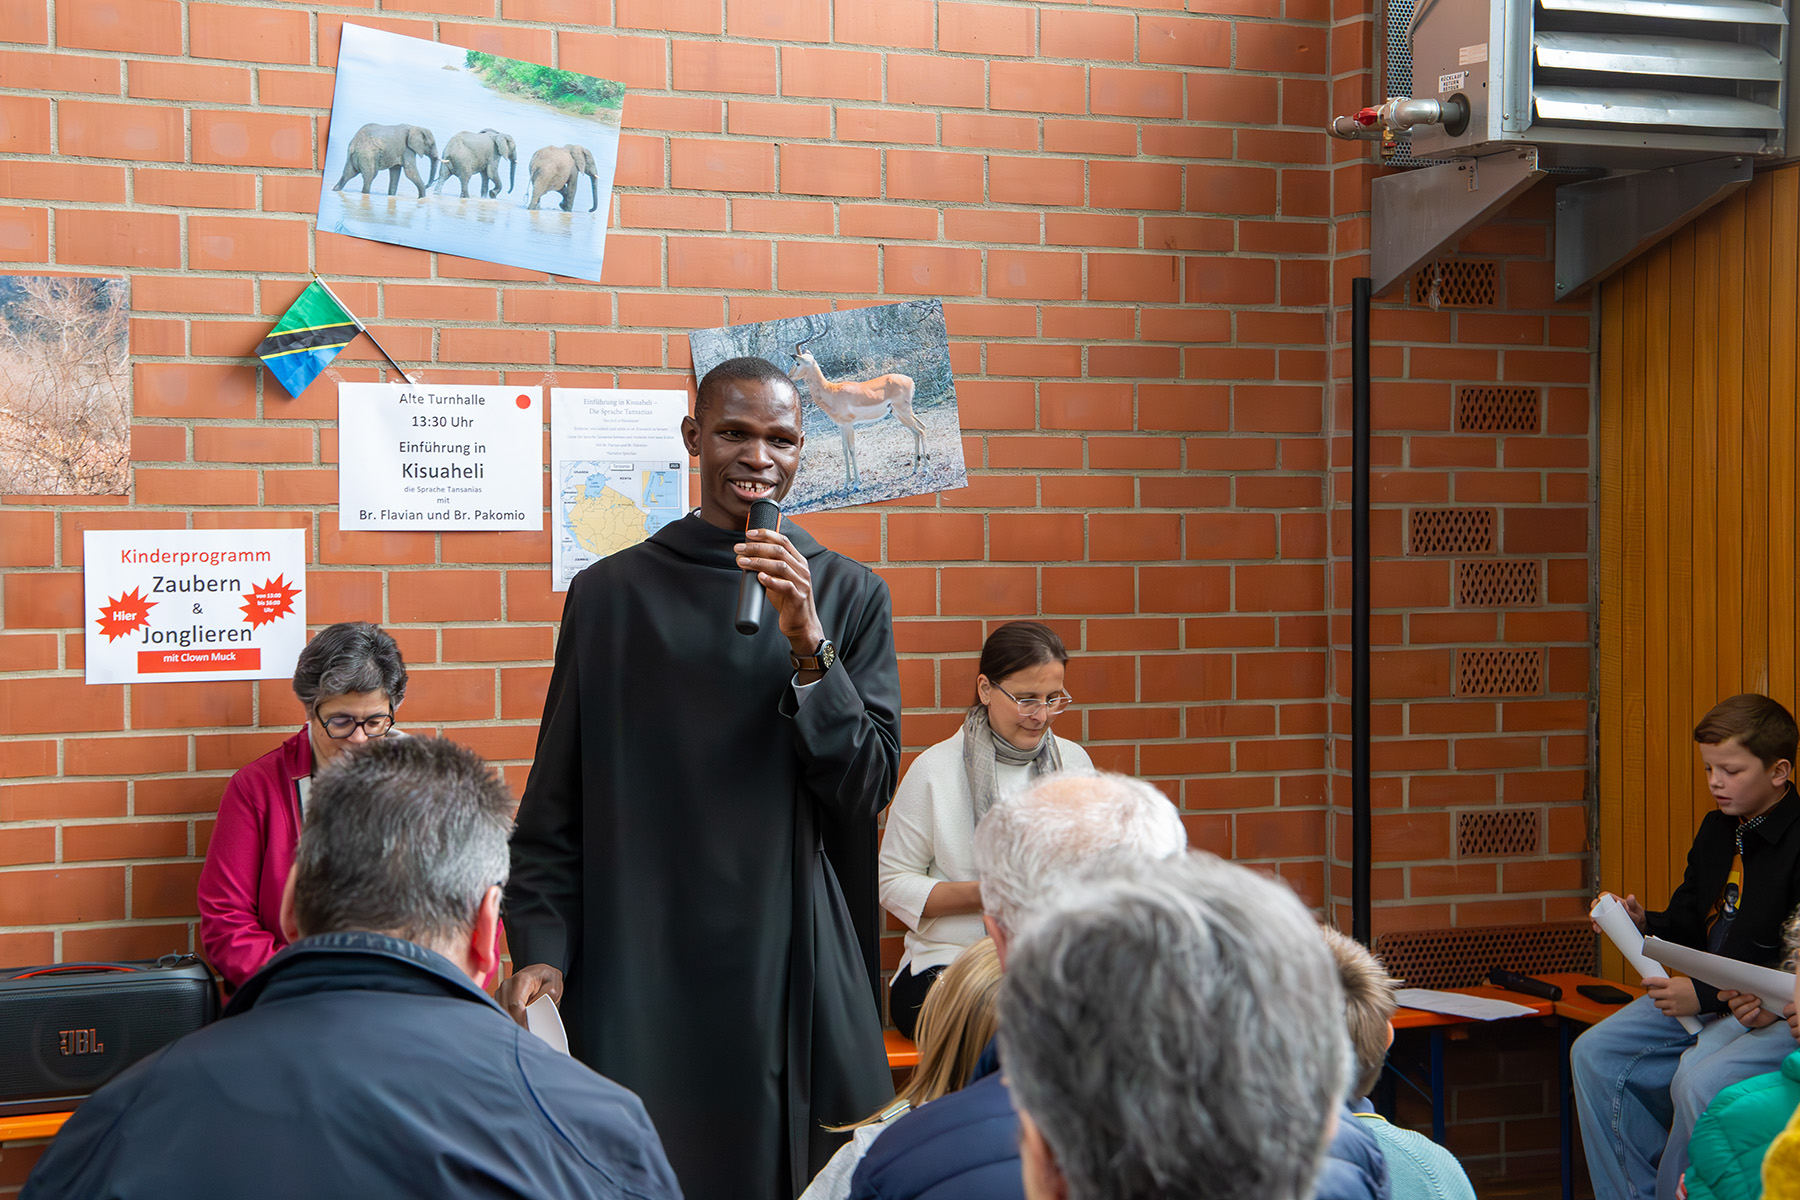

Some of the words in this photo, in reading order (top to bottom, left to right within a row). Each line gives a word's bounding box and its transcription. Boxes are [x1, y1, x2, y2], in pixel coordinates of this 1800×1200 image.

[399, 393, 424, 404] Alte
[428, 394, 485, 405] Turnhalle
[583, 398, 618, 407] Einführung
[600, 408, 623, 416] Sprache
[412, 416, 446, 427] 13:30
[451, 416, 473, 427] Uhr
[400, 441, 470, 456] Einführung
[475, 442, 485, 453] in
[403, 463, 483, 478] Kisuaheli
[360, 510, 376, 520] Br.
[381, 510, 423, 520] Flavian
[428, 510, 449, 520] und
[455, 510, 470, 520] Br.
[475, 510, 525, 520] Pakomio
[122, 549, 270, 566] Kinderprogramm
[153, 575, 240, 592] Zaubern
[193, 603, 203, 614] &
[113, 611, 137, 621] Hier
[142, 626, 251, 647] Jonglieren
[163, 654, 179, 662] mit
[181, 653, 209, 662] Clown
[211, 652, 236, 661] Muck
[58, 1028, 104, 1056] JBL
